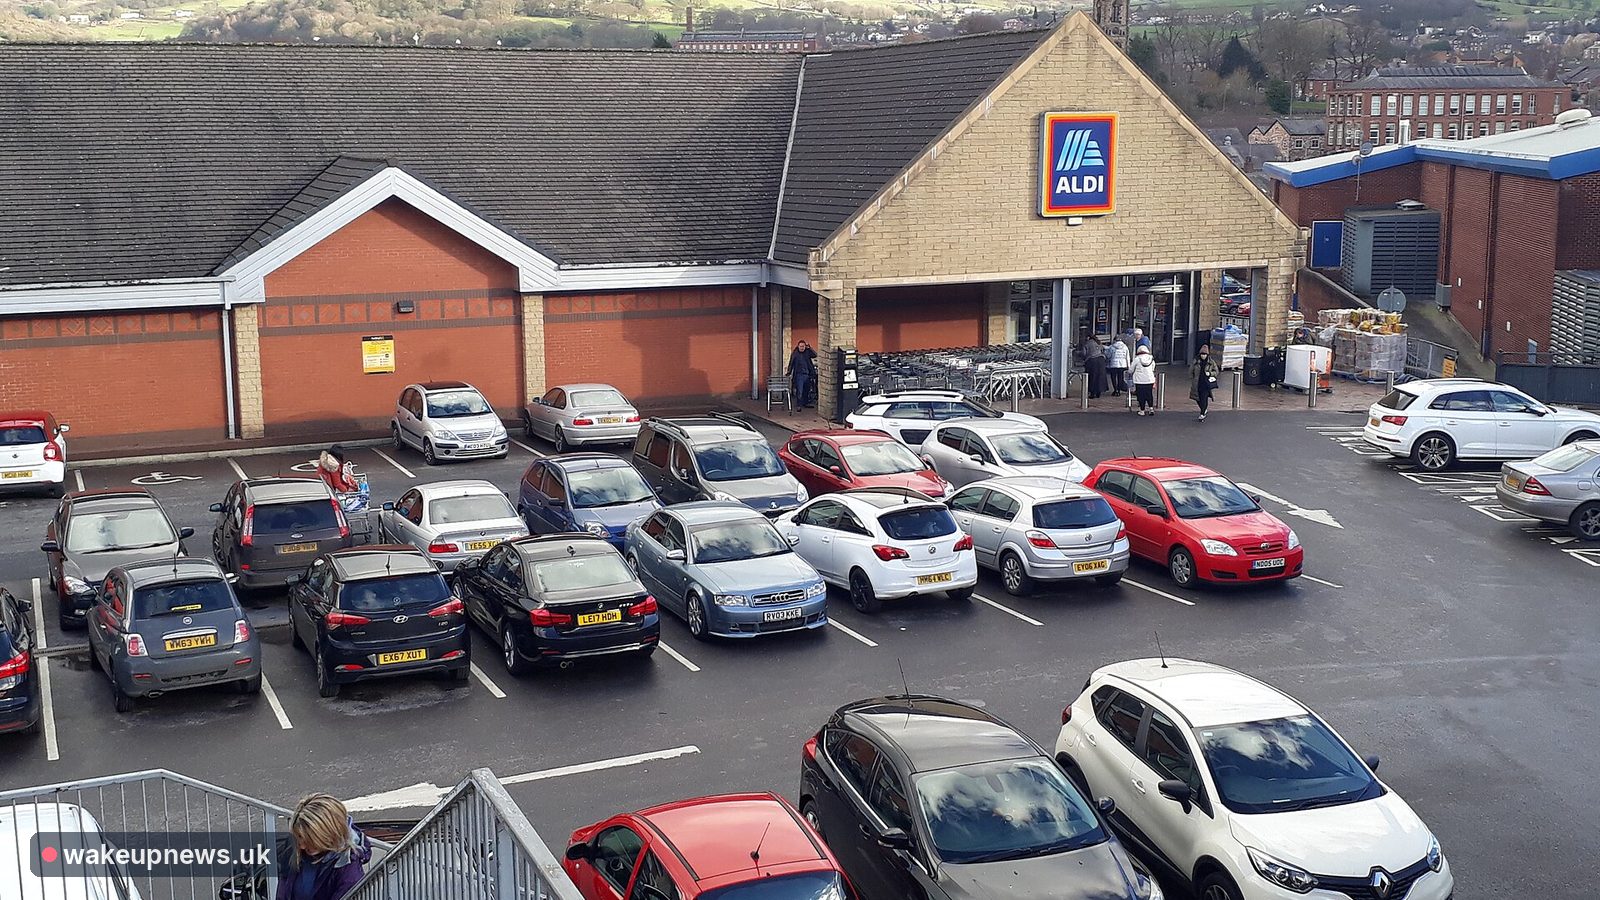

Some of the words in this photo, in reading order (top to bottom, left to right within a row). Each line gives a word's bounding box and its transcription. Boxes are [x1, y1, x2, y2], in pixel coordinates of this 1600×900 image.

[1056, 175, 1104, 194] ALDI
[582, 614, 600, 623] LE17
[602, 612, 617, 621] HDH
[766, 611, 785, 620] RV03
[383, 652, 405, 662] EX67
[406, 650, 422, 659] XUT
